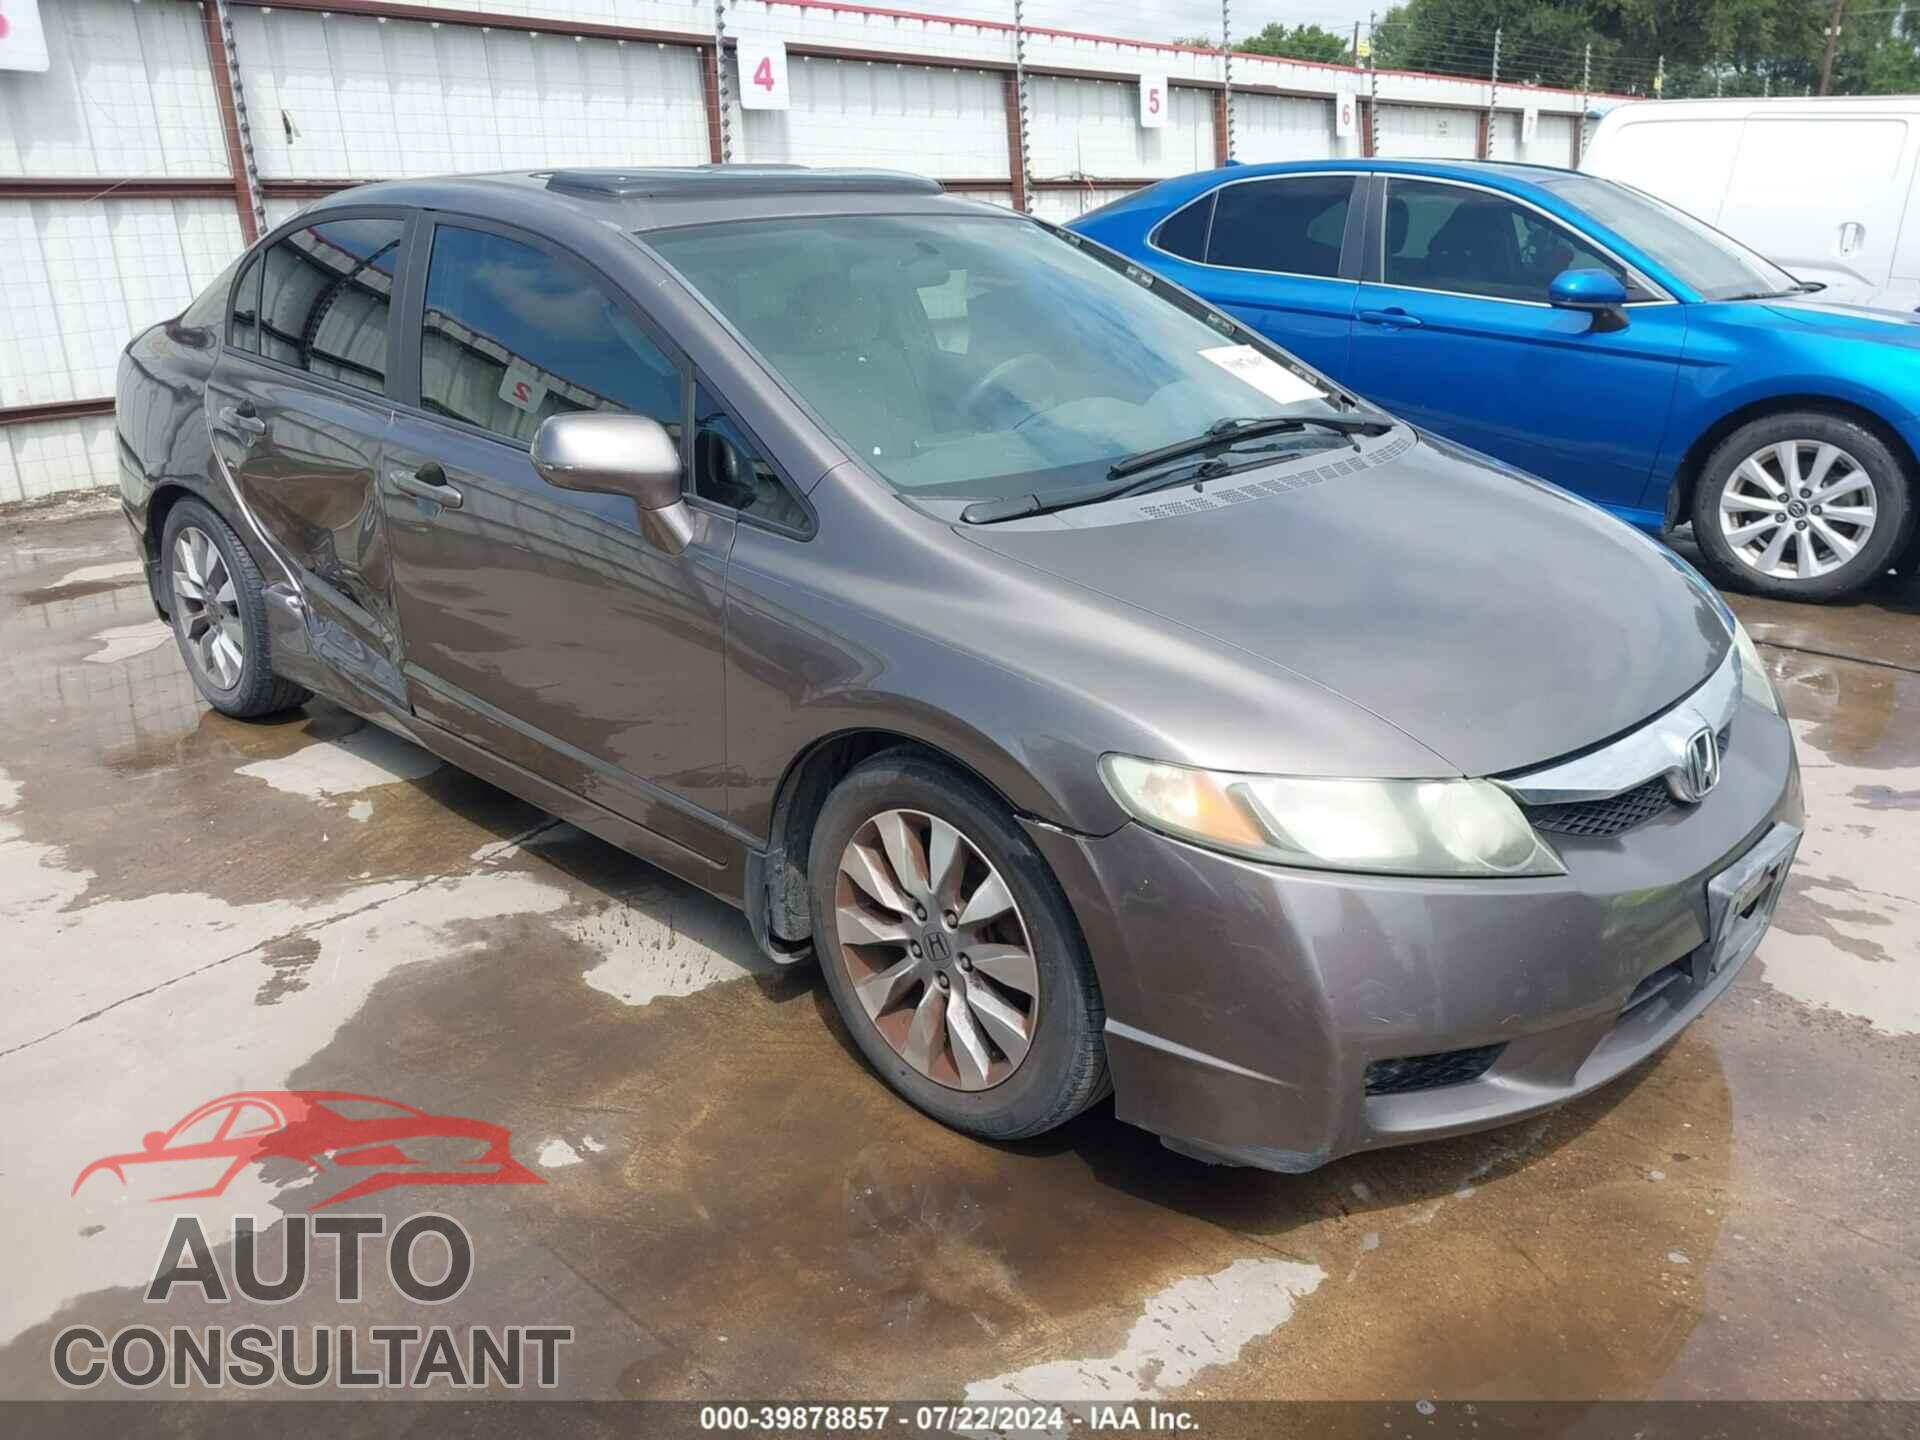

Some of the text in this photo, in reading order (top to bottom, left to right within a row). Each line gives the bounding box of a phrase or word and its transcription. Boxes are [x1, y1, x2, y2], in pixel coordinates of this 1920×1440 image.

[753, 56, 774, 91] 4
[1150, 88, 1160, 114] 5
[1343, 104, 1350, 126] 6
